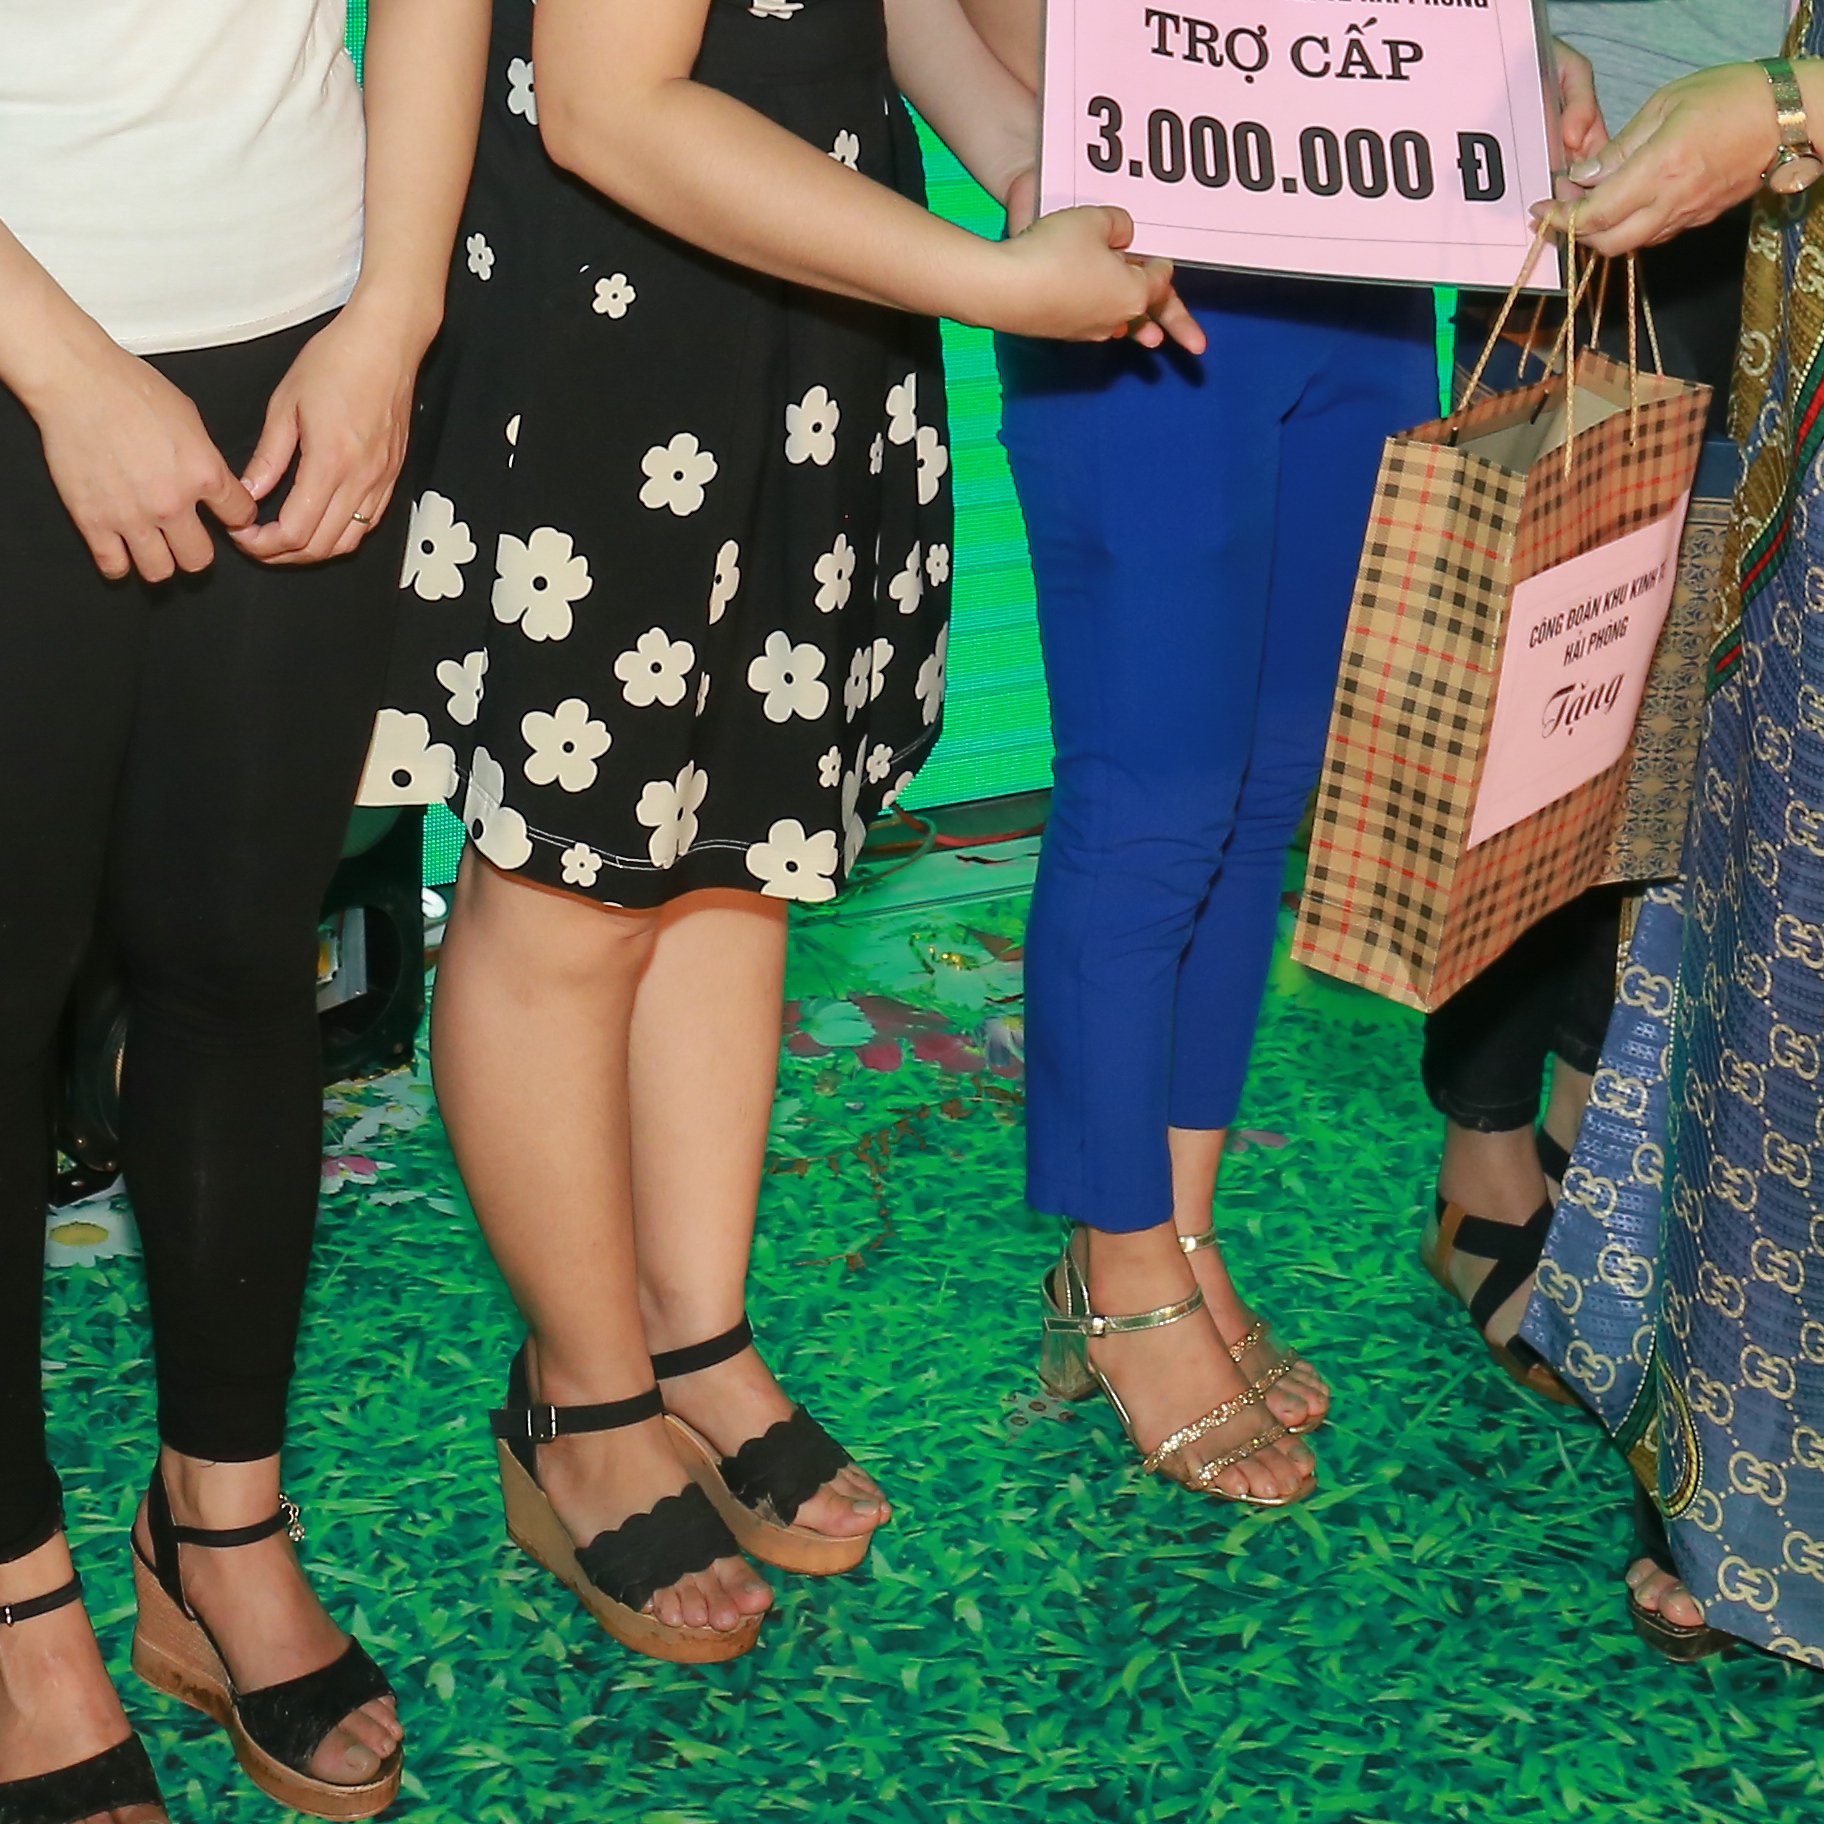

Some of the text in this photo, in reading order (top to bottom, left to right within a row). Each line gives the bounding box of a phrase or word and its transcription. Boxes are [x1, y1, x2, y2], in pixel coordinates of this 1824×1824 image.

[1145, 7, 1424, 85] TRỢ CẤP
[1086, 96, 1506, 202] 3.000.000 Đ
[1529, 613, 1564, 649] CÔNG
[1566, 596, 1603, 630] ĐOÀN
[1602, 583, 1629, 613] KHU
[1587, 615, 1629, 656] PHÒNG
[1542, 673, 1624, 739] Tặng
